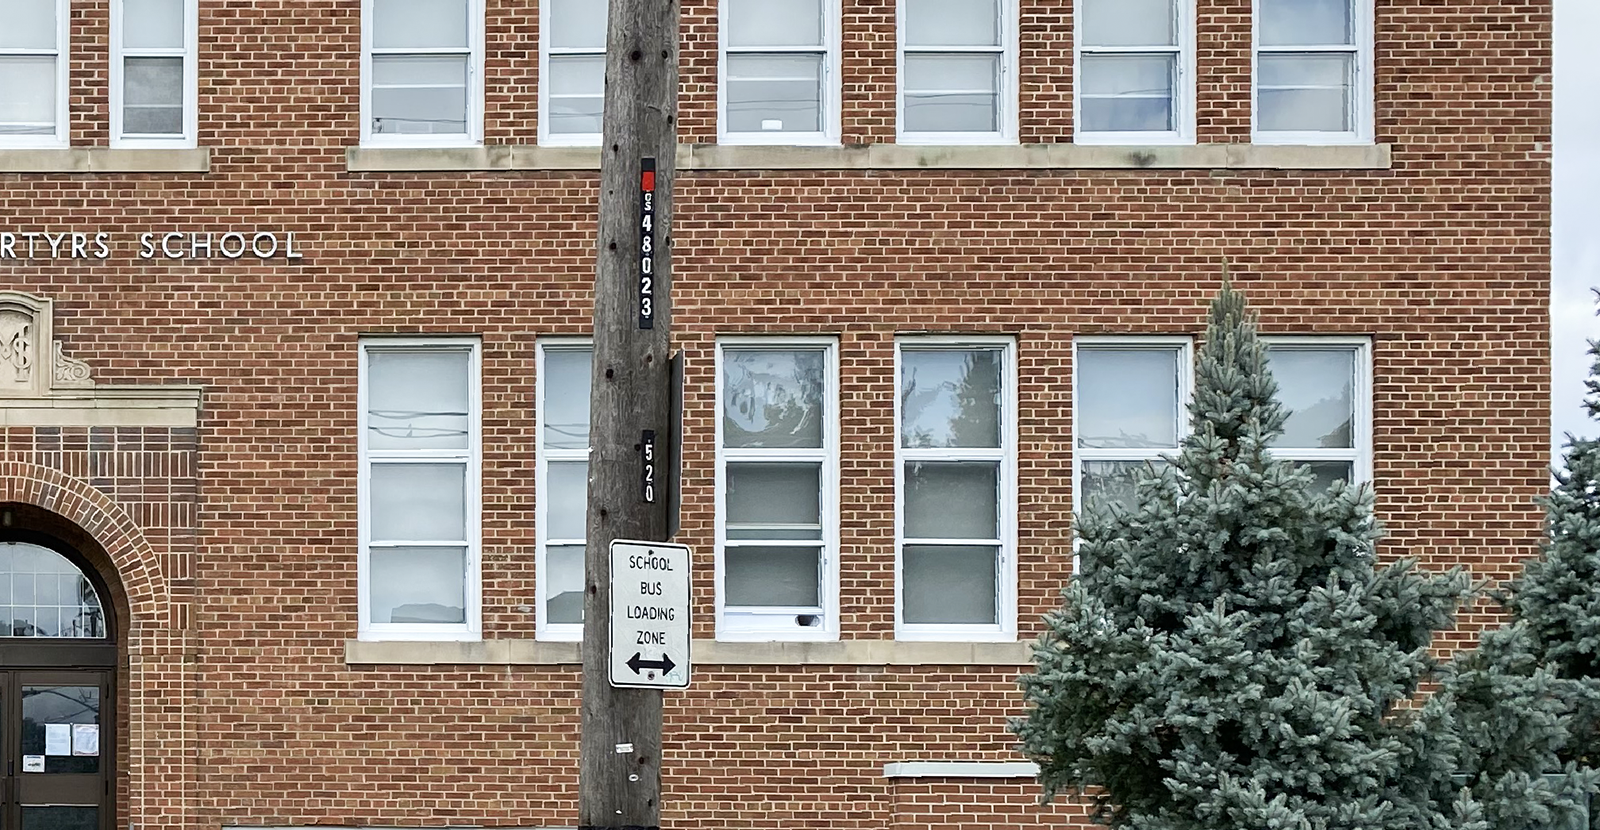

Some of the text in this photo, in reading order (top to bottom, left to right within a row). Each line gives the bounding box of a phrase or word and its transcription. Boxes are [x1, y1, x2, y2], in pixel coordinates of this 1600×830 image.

[140, 231, 303, 258] SCHOOL
[641, 214, 652, 316] 48023
[645, 444, 653, 502] 520
[629, 555, 673, 571] SCHOOL
[640, 581, 662, 595] BUS
[627, 605, 675, 621] LOADING
[636, 631, 666, 645] ZONE
